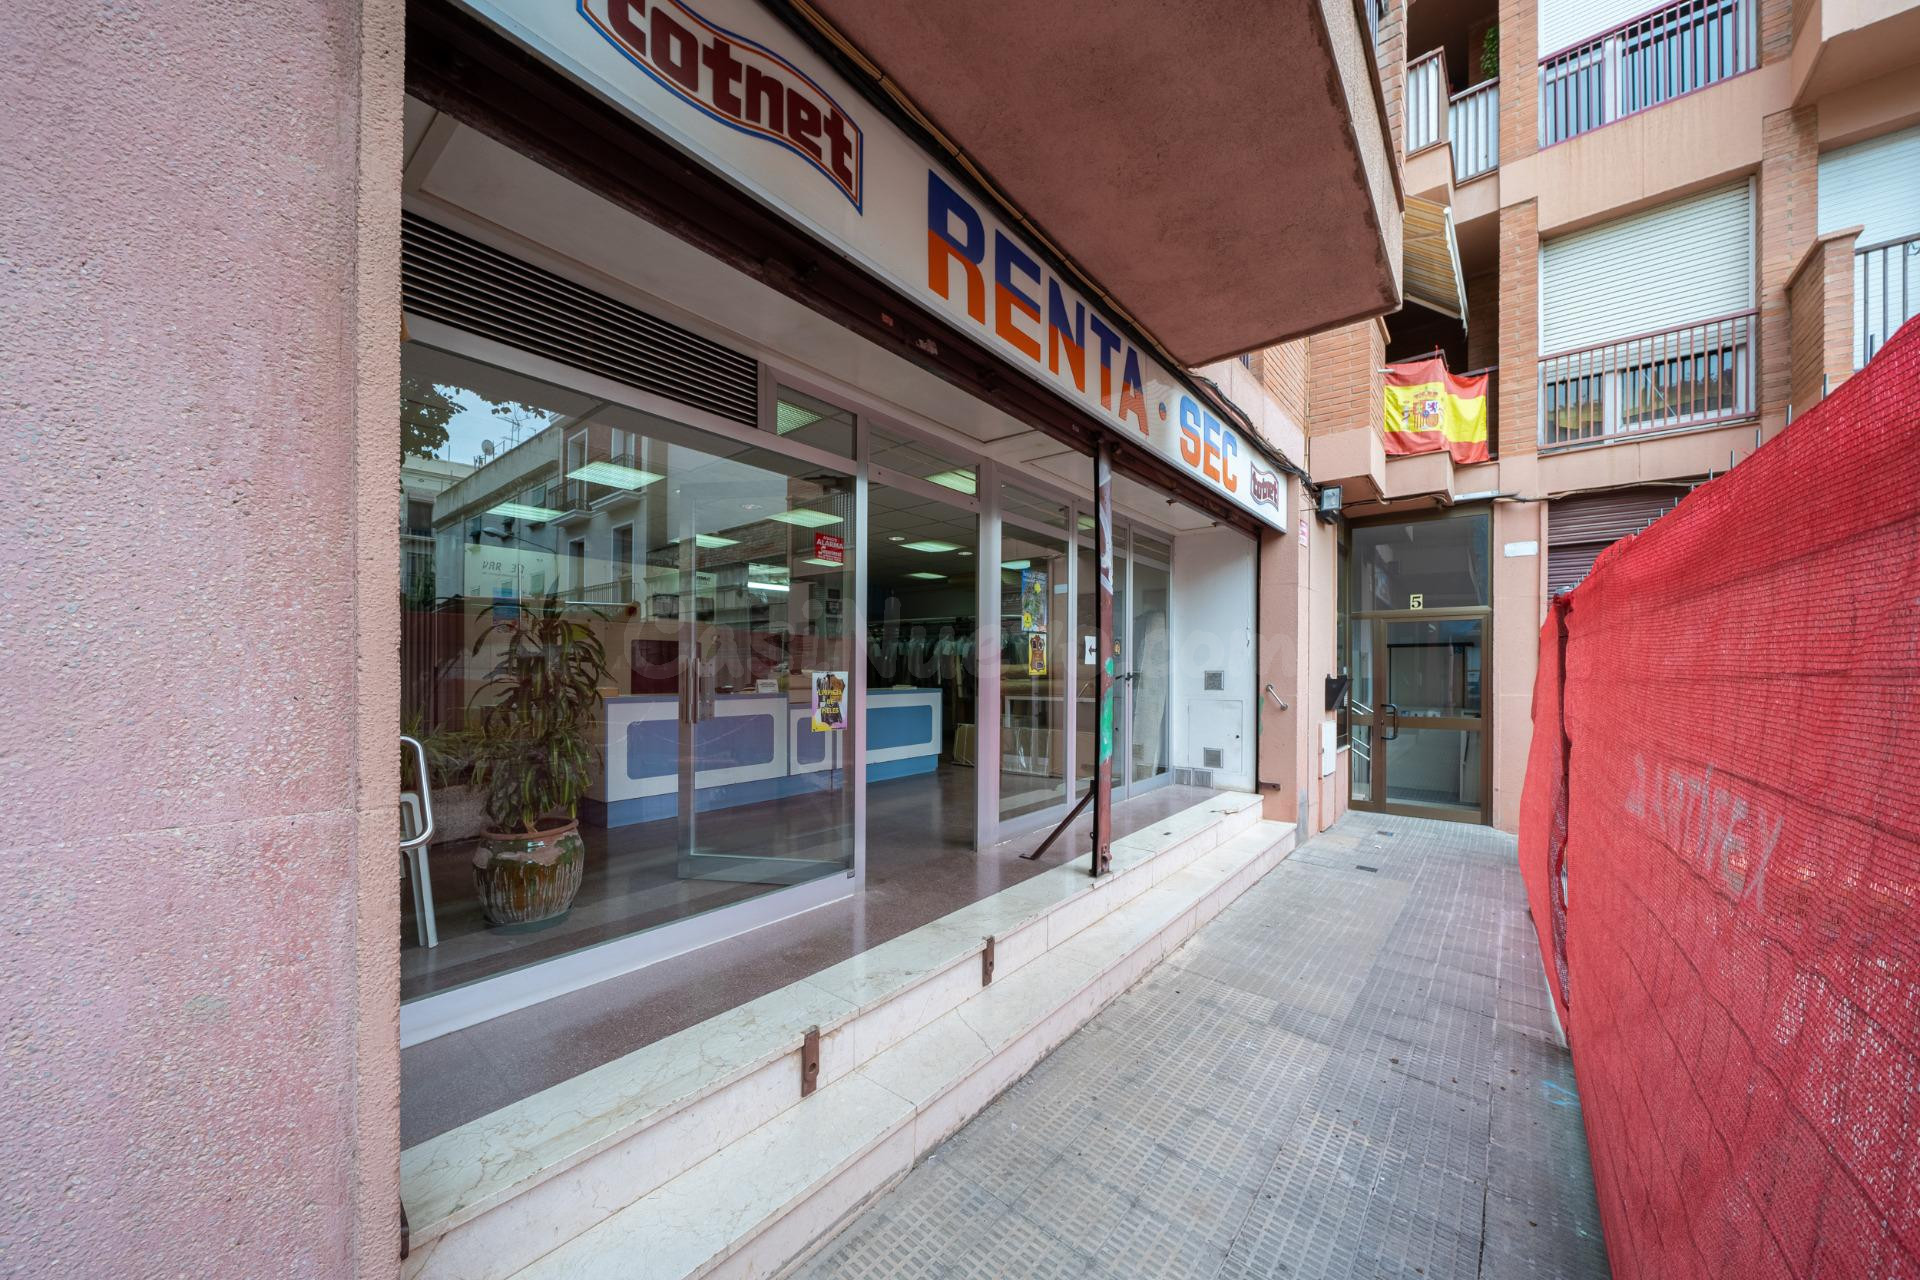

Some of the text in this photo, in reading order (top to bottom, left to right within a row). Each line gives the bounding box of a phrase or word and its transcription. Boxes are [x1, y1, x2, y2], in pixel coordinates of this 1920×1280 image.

[928, 168, 1238, 494] RENTA SEC
[816, 538, 844, 550] ALARMA
[1411, 596, 1421, 608] 5
